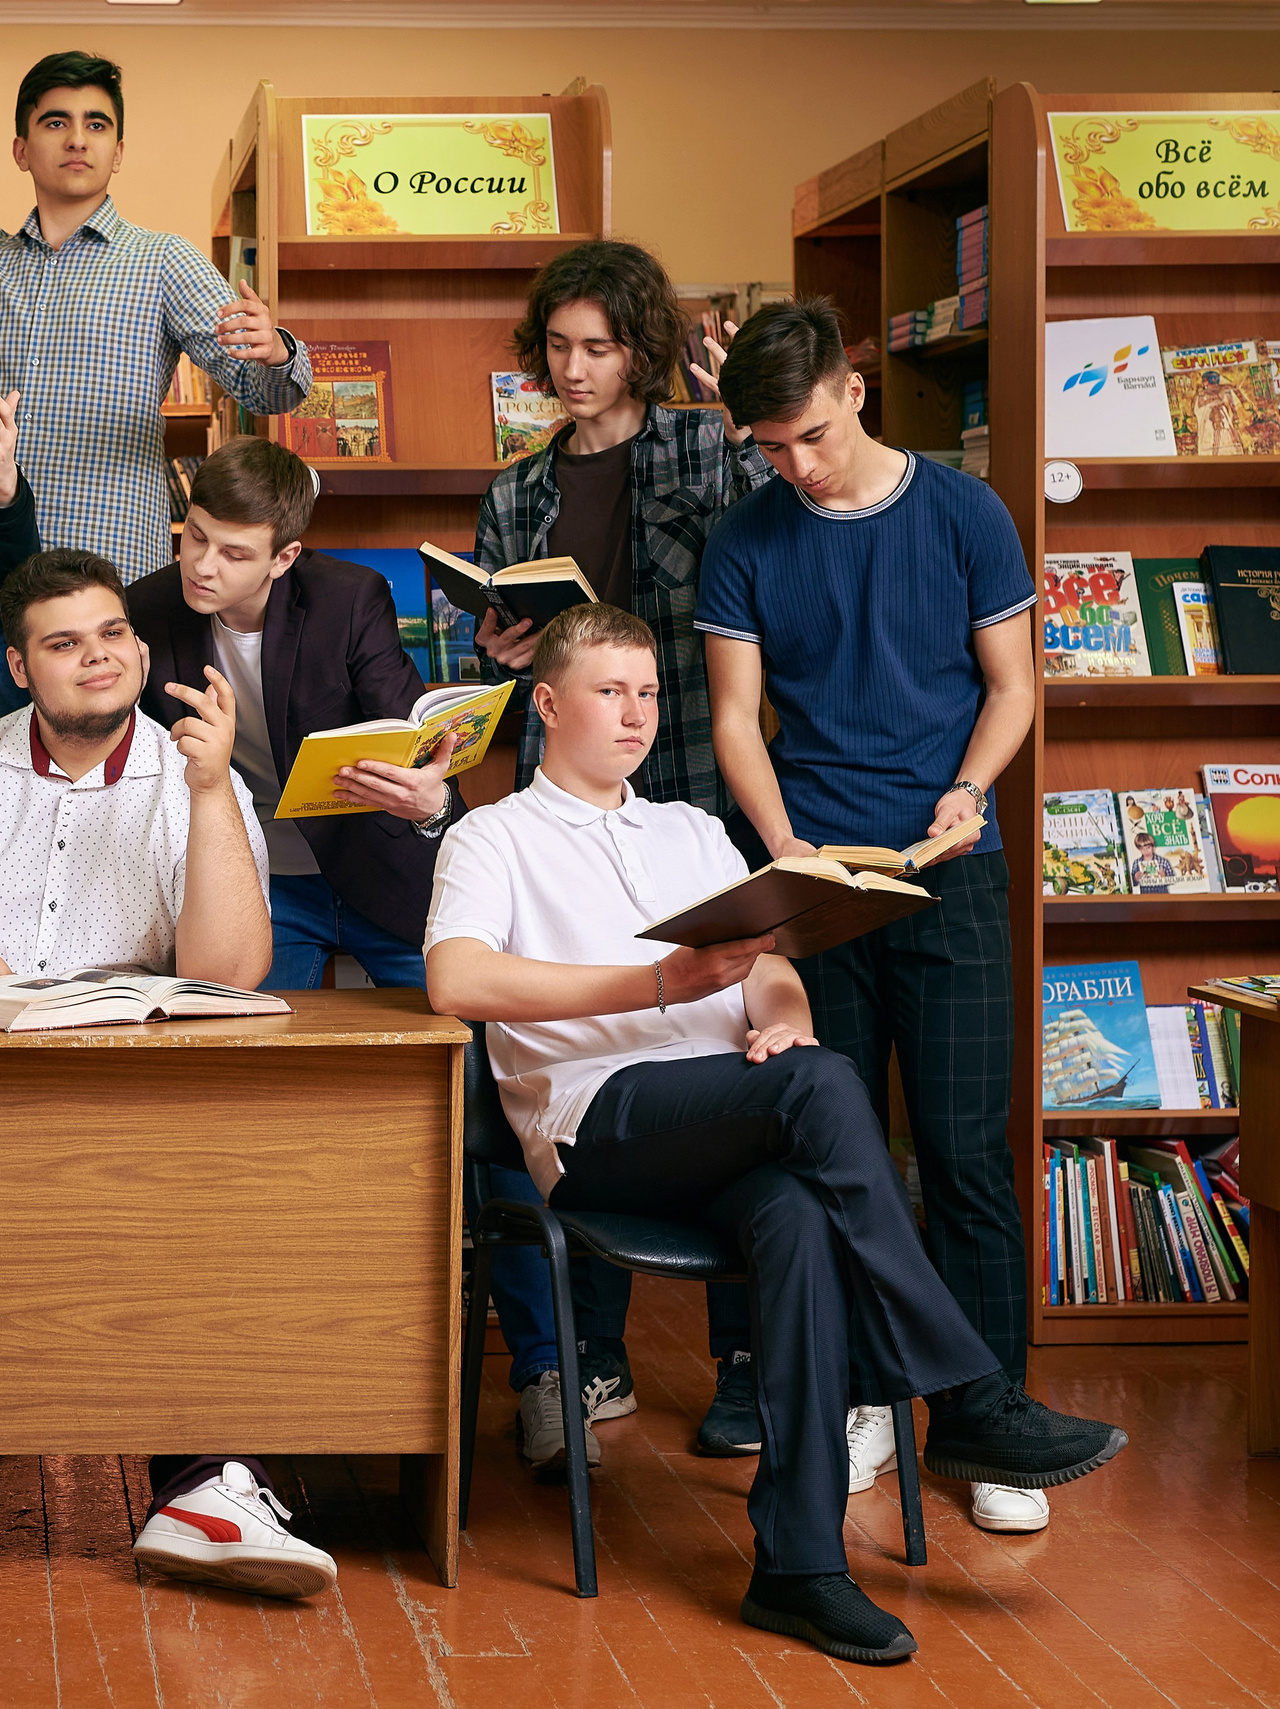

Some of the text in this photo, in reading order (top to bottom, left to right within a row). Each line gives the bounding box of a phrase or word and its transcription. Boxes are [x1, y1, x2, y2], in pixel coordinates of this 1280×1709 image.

[1156, 139, 1212, 163] Всё
[373, 170, 528, 194] О России
[1138, 170, 1269, 199] обо всём
[1171, 349, 1250, 371] ЕГИПЕТ
[1117, 375, 1155, 385] Барнаул
[1123, 382, 1157, 390] Barnaul
[1050, 472, 1071, 483] 12+
[1237, 569, 1273, 578] ИСТОРИЯ
[1146, 812, 1165, 824] ХОЧУ
[1151, 819, 1183, 836] ВСЁ
[1164, 834, 1188, 845] ЗНАТЬ
[1092, 1205, 1101, 1245] ДЕТСКАЯ
[1185, 1214, 1200, 1238] МИР
[1096, 1248, 1105, 1293] ЭНЦИКЛОПЕДИЯ
[1192, 1238, 1213, 1283] ПОЗНАЮ
